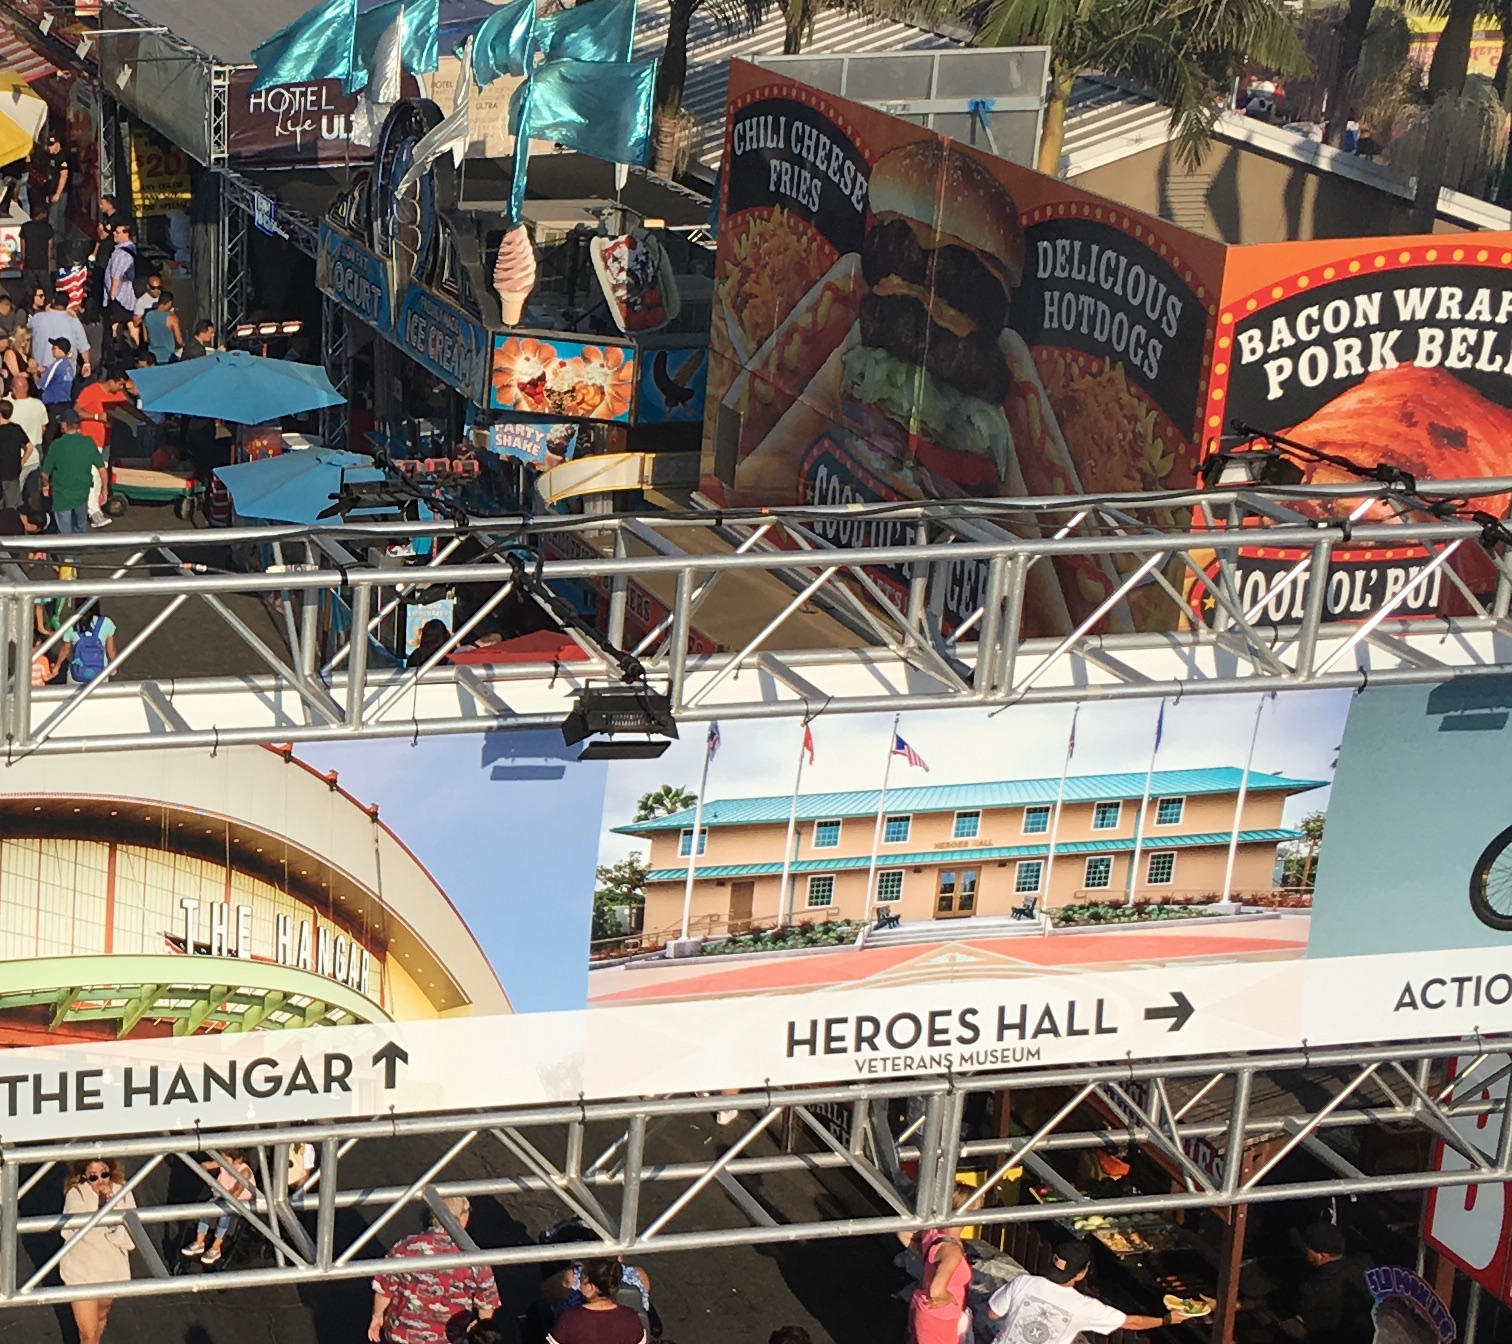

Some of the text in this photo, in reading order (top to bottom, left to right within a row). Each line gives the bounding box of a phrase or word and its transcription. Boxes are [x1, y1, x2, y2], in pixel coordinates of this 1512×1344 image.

[250, 86, 334, 114] HOTEL
[321, 114, 355, 140] UL
[733, 114, 868, 214] CHILI CHEESE
[769, 158, 822, 213] FRIES
[329, 253, 382, 321] YOGURT
[1036, 238, 1183, 338] DELICIOUS
[406, 309, 427, 353] ICE
[428, 325, 472, 389] CREAM
[1043, 290, 1163, 380] HOTDOGS
[1237, 291, 1383, 365] BACON
[1263, 326, 1512, 401] PORK BEL
[494, 423, 545, 443] PARTY
[495, 434, 541, 456] SHAKE
[1233, 569, 1310, 626] OO
[180, 897, 370, 995] THE HANGAR
[786, 998, 1119, 1058] HEROES HALL
[123, 1052, 353, 1108] HANGAR
[854, 1046, 1042, 1074] VETERANS MUSEUM
